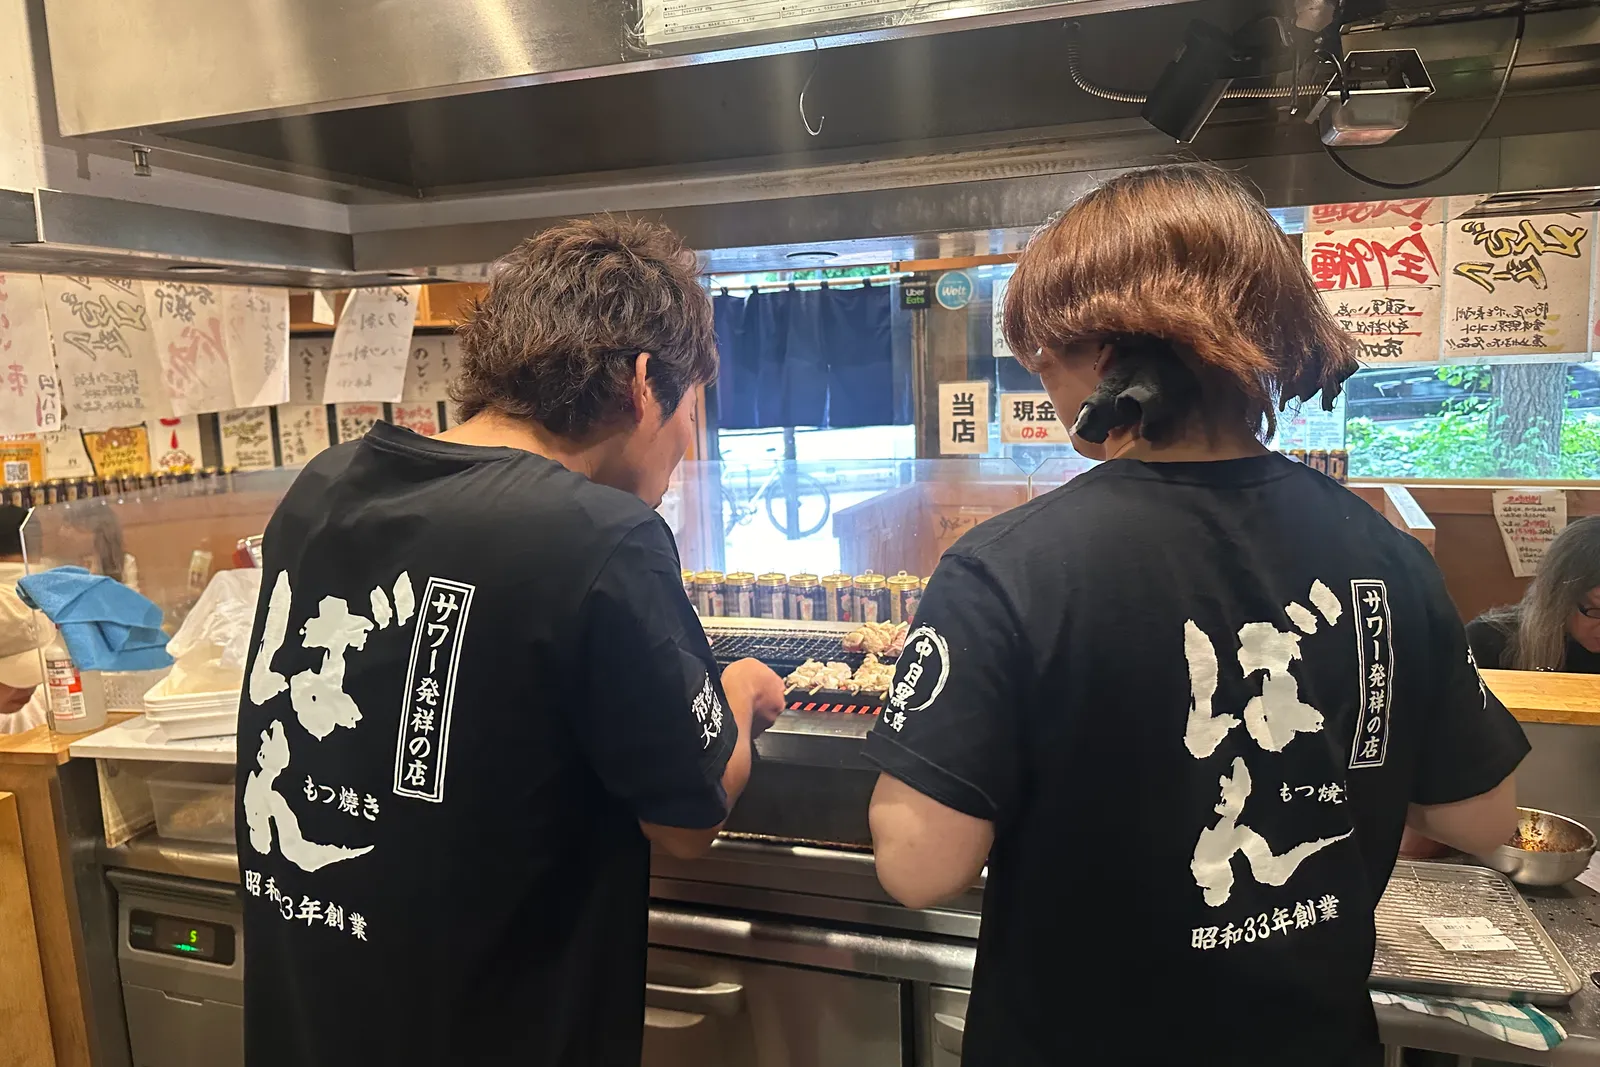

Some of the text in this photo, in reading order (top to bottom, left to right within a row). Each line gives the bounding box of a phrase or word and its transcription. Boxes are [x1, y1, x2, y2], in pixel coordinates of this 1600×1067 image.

[906, 288, 925, 296] Uber
[906, 296, 925, 304] Eats
[942, 287, 966, 296] Wolt
[952, 392, 975, 443] 当店
[1013, 400, 1057, 421] 現金
[1021, 426, 1048, 438] のみ
[404, 594, 458, 787] サワー発祥の店
[1361, 590, 1386, 759] サワー発祥の店
[303, 775, 380, 822] もつ焼き
[1279, 780, 1348, 804] もつ焼
[244, 869, 368, 941] 昭和3年創業
[1191, 893, 1340, 950] 昭和33年創業
